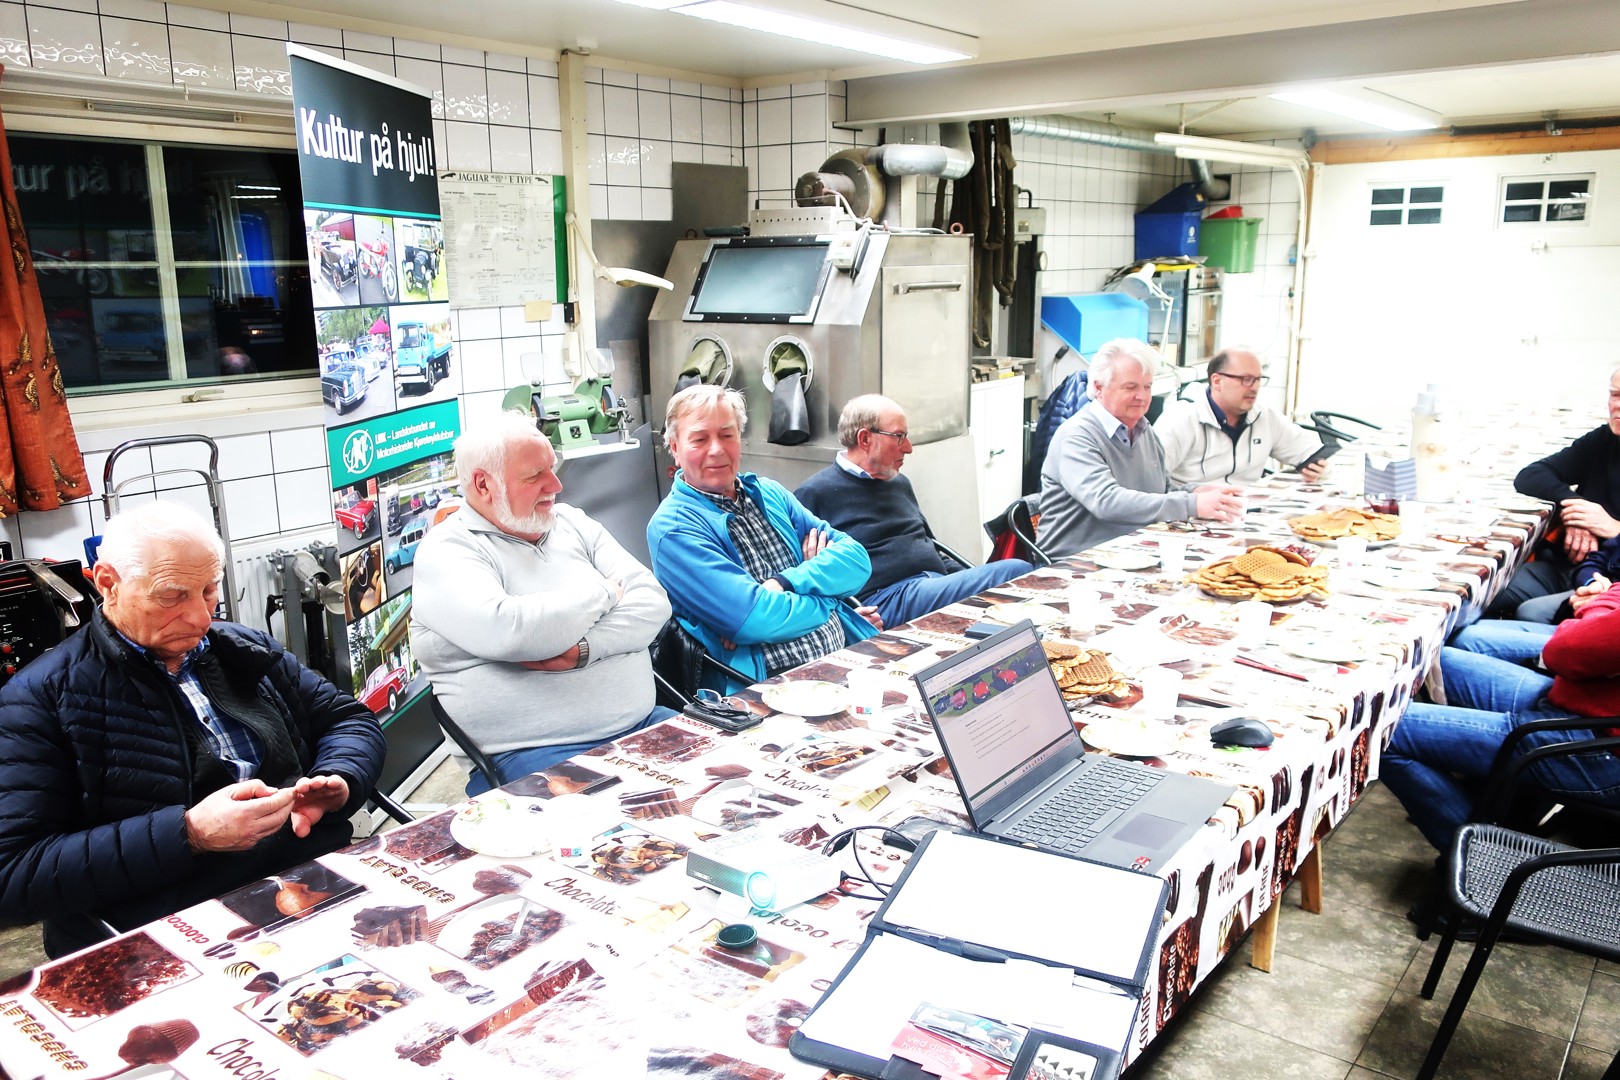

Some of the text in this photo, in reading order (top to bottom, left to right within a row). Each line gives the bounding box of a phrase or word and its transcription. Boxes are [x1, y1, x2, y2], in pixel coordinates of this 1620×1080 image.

[300, 106, 435, 182] Kultur på hjul!
[458, 172, 490, 183] JAGUAR
[516, 175, 533, 184] TYPE
[1162, 943, 1177, 1022] Chocolate
